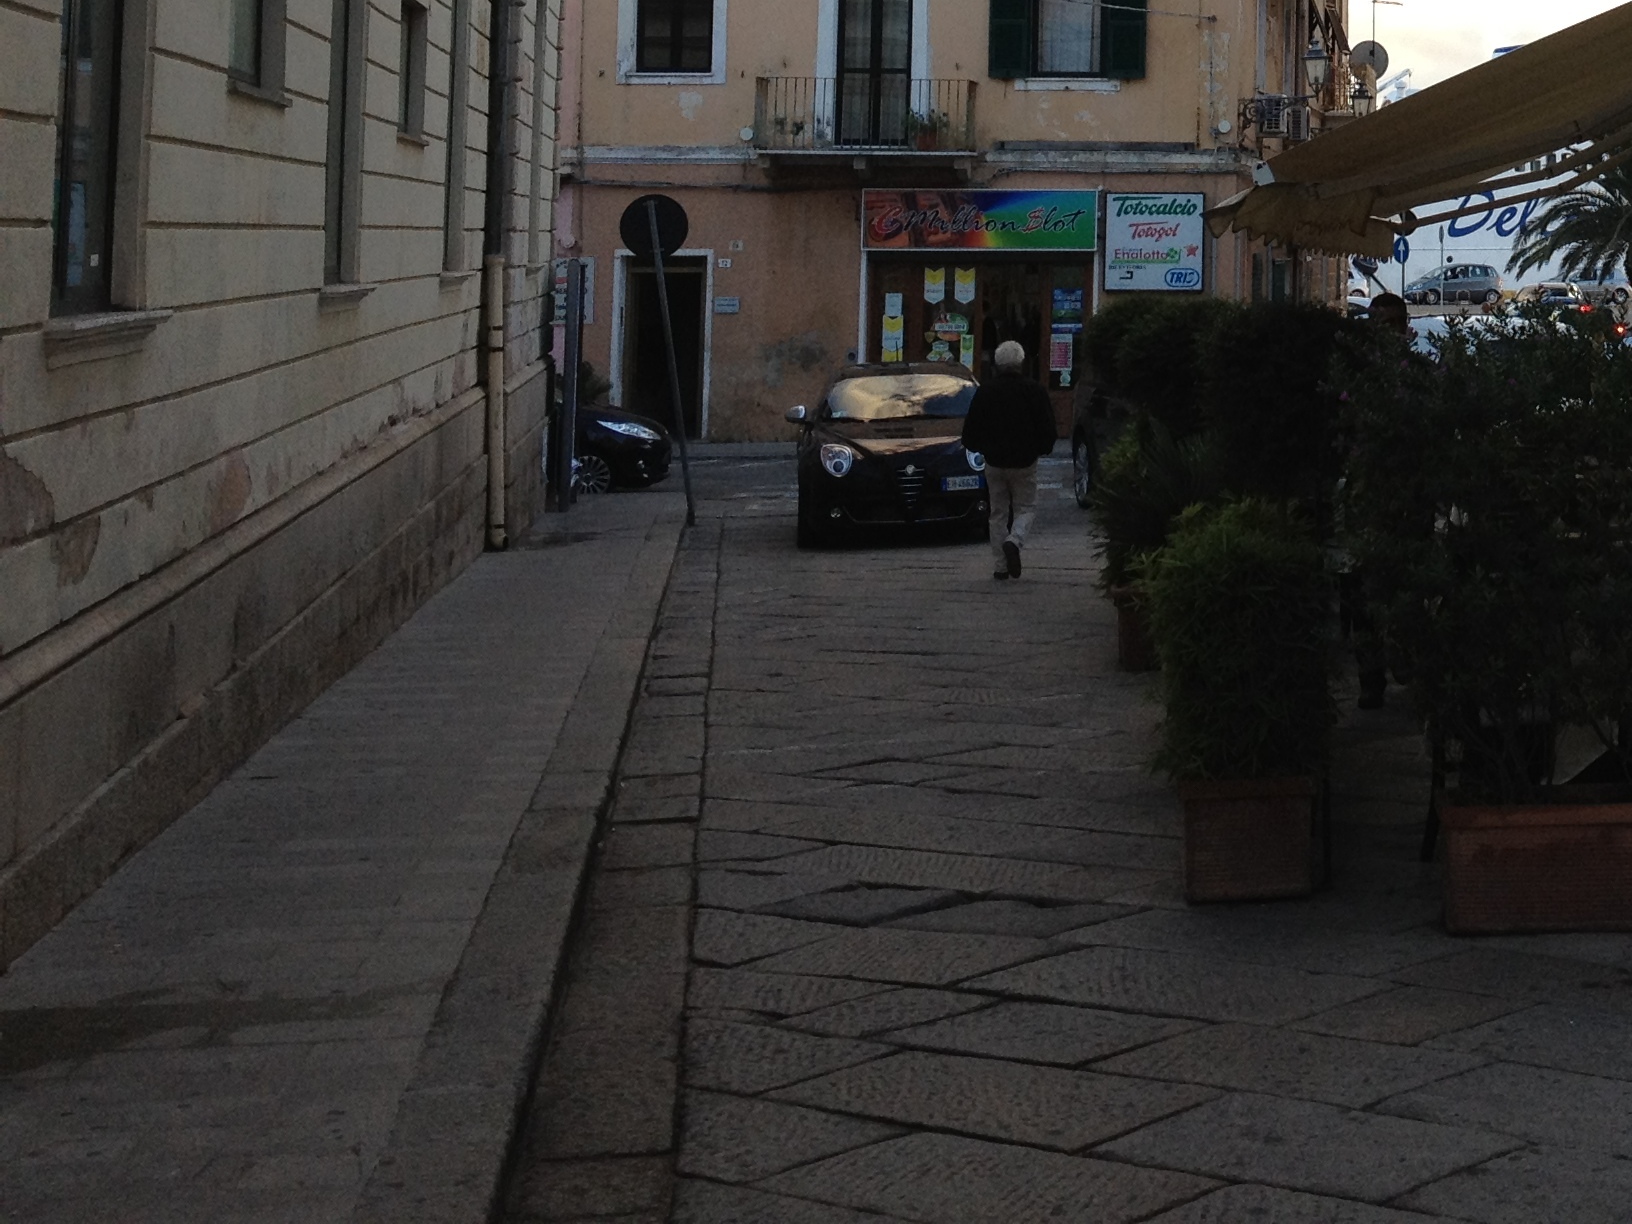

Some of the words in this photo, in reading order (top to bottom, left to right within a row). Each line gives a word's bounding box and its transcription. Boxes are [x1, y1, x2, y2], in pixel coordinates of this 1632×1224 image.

[1113, 196, 1198, 217] Totocalcio
[903, 204, 1020, 234] Million
[1128, 221, 1181, 242] Totogol
[1114, 248, 1169, 260] Enalotto
